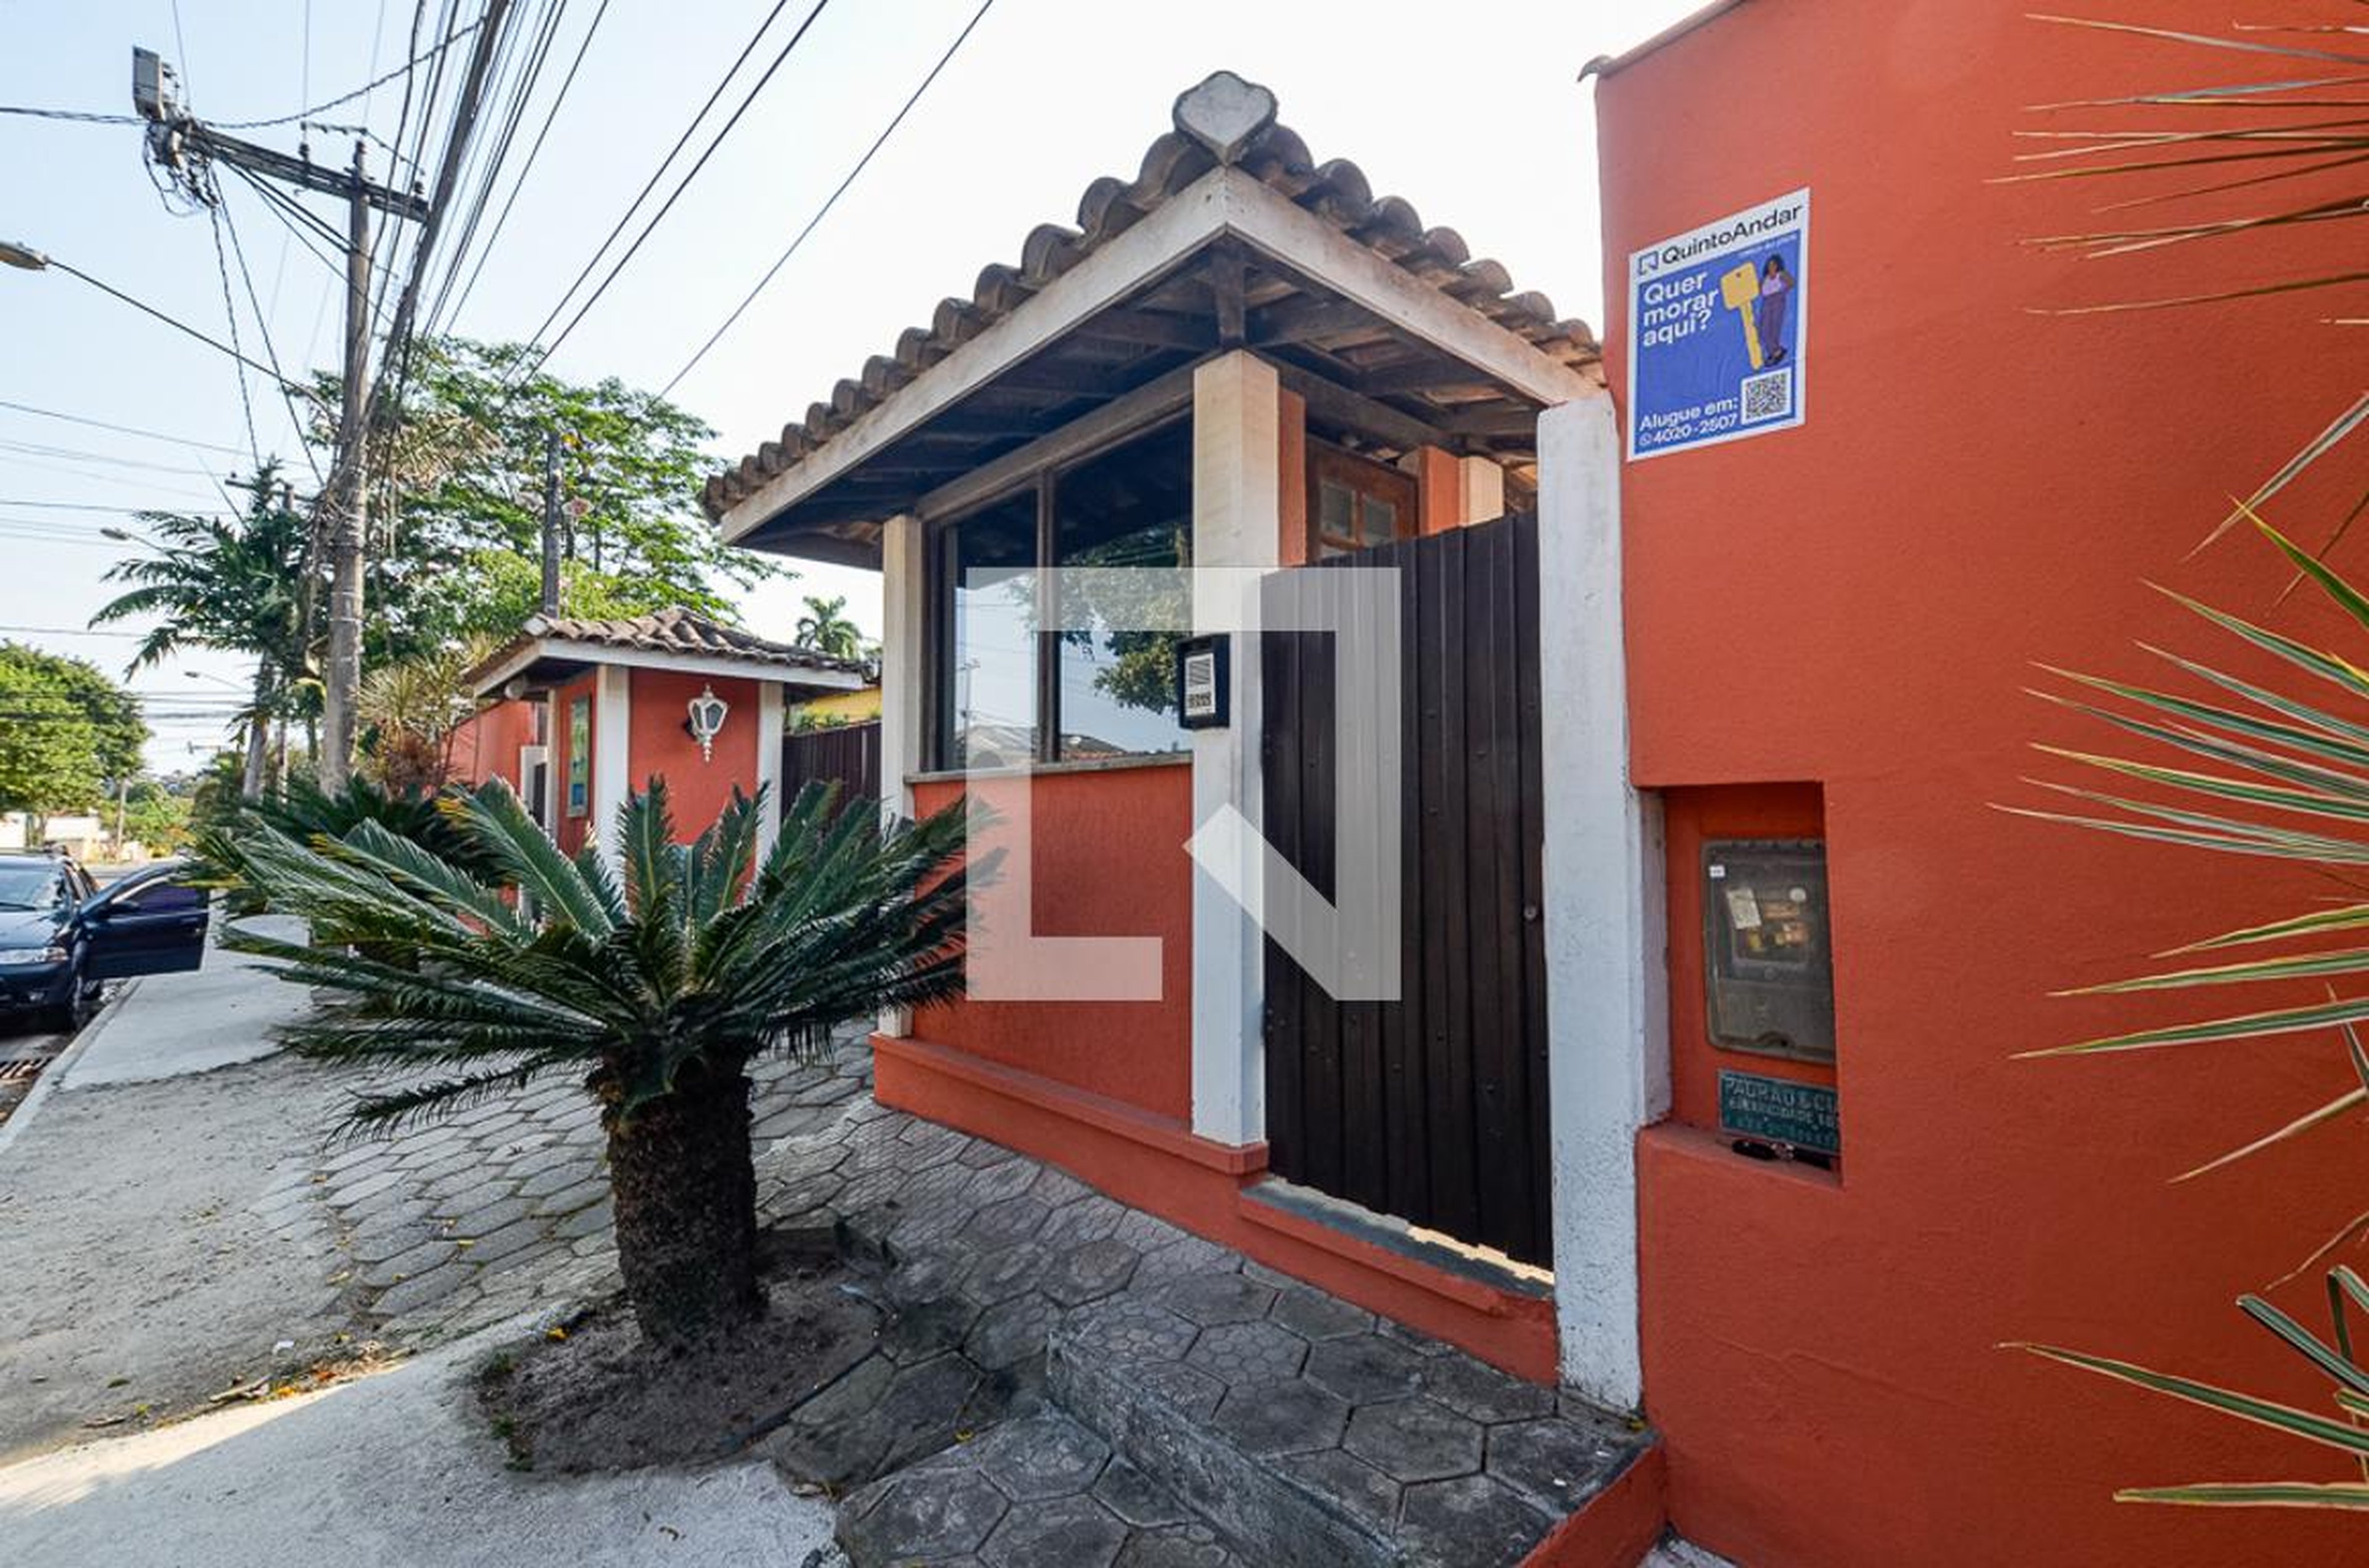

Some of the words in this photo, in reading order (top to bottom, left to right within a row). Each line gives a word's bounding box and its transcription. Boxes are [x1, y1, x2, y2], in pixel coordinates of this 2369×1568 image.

[1662, 205, 1802, 264] QuintoAndar
[1645, 272, 1707, 305] Quer
[1644, 289, 1719, 326] morar
[1643, 309, 1711, 346] aqui?
[1639, 407, 1701, 432] Alugue
[1705, 397, 1739, 415] em:
